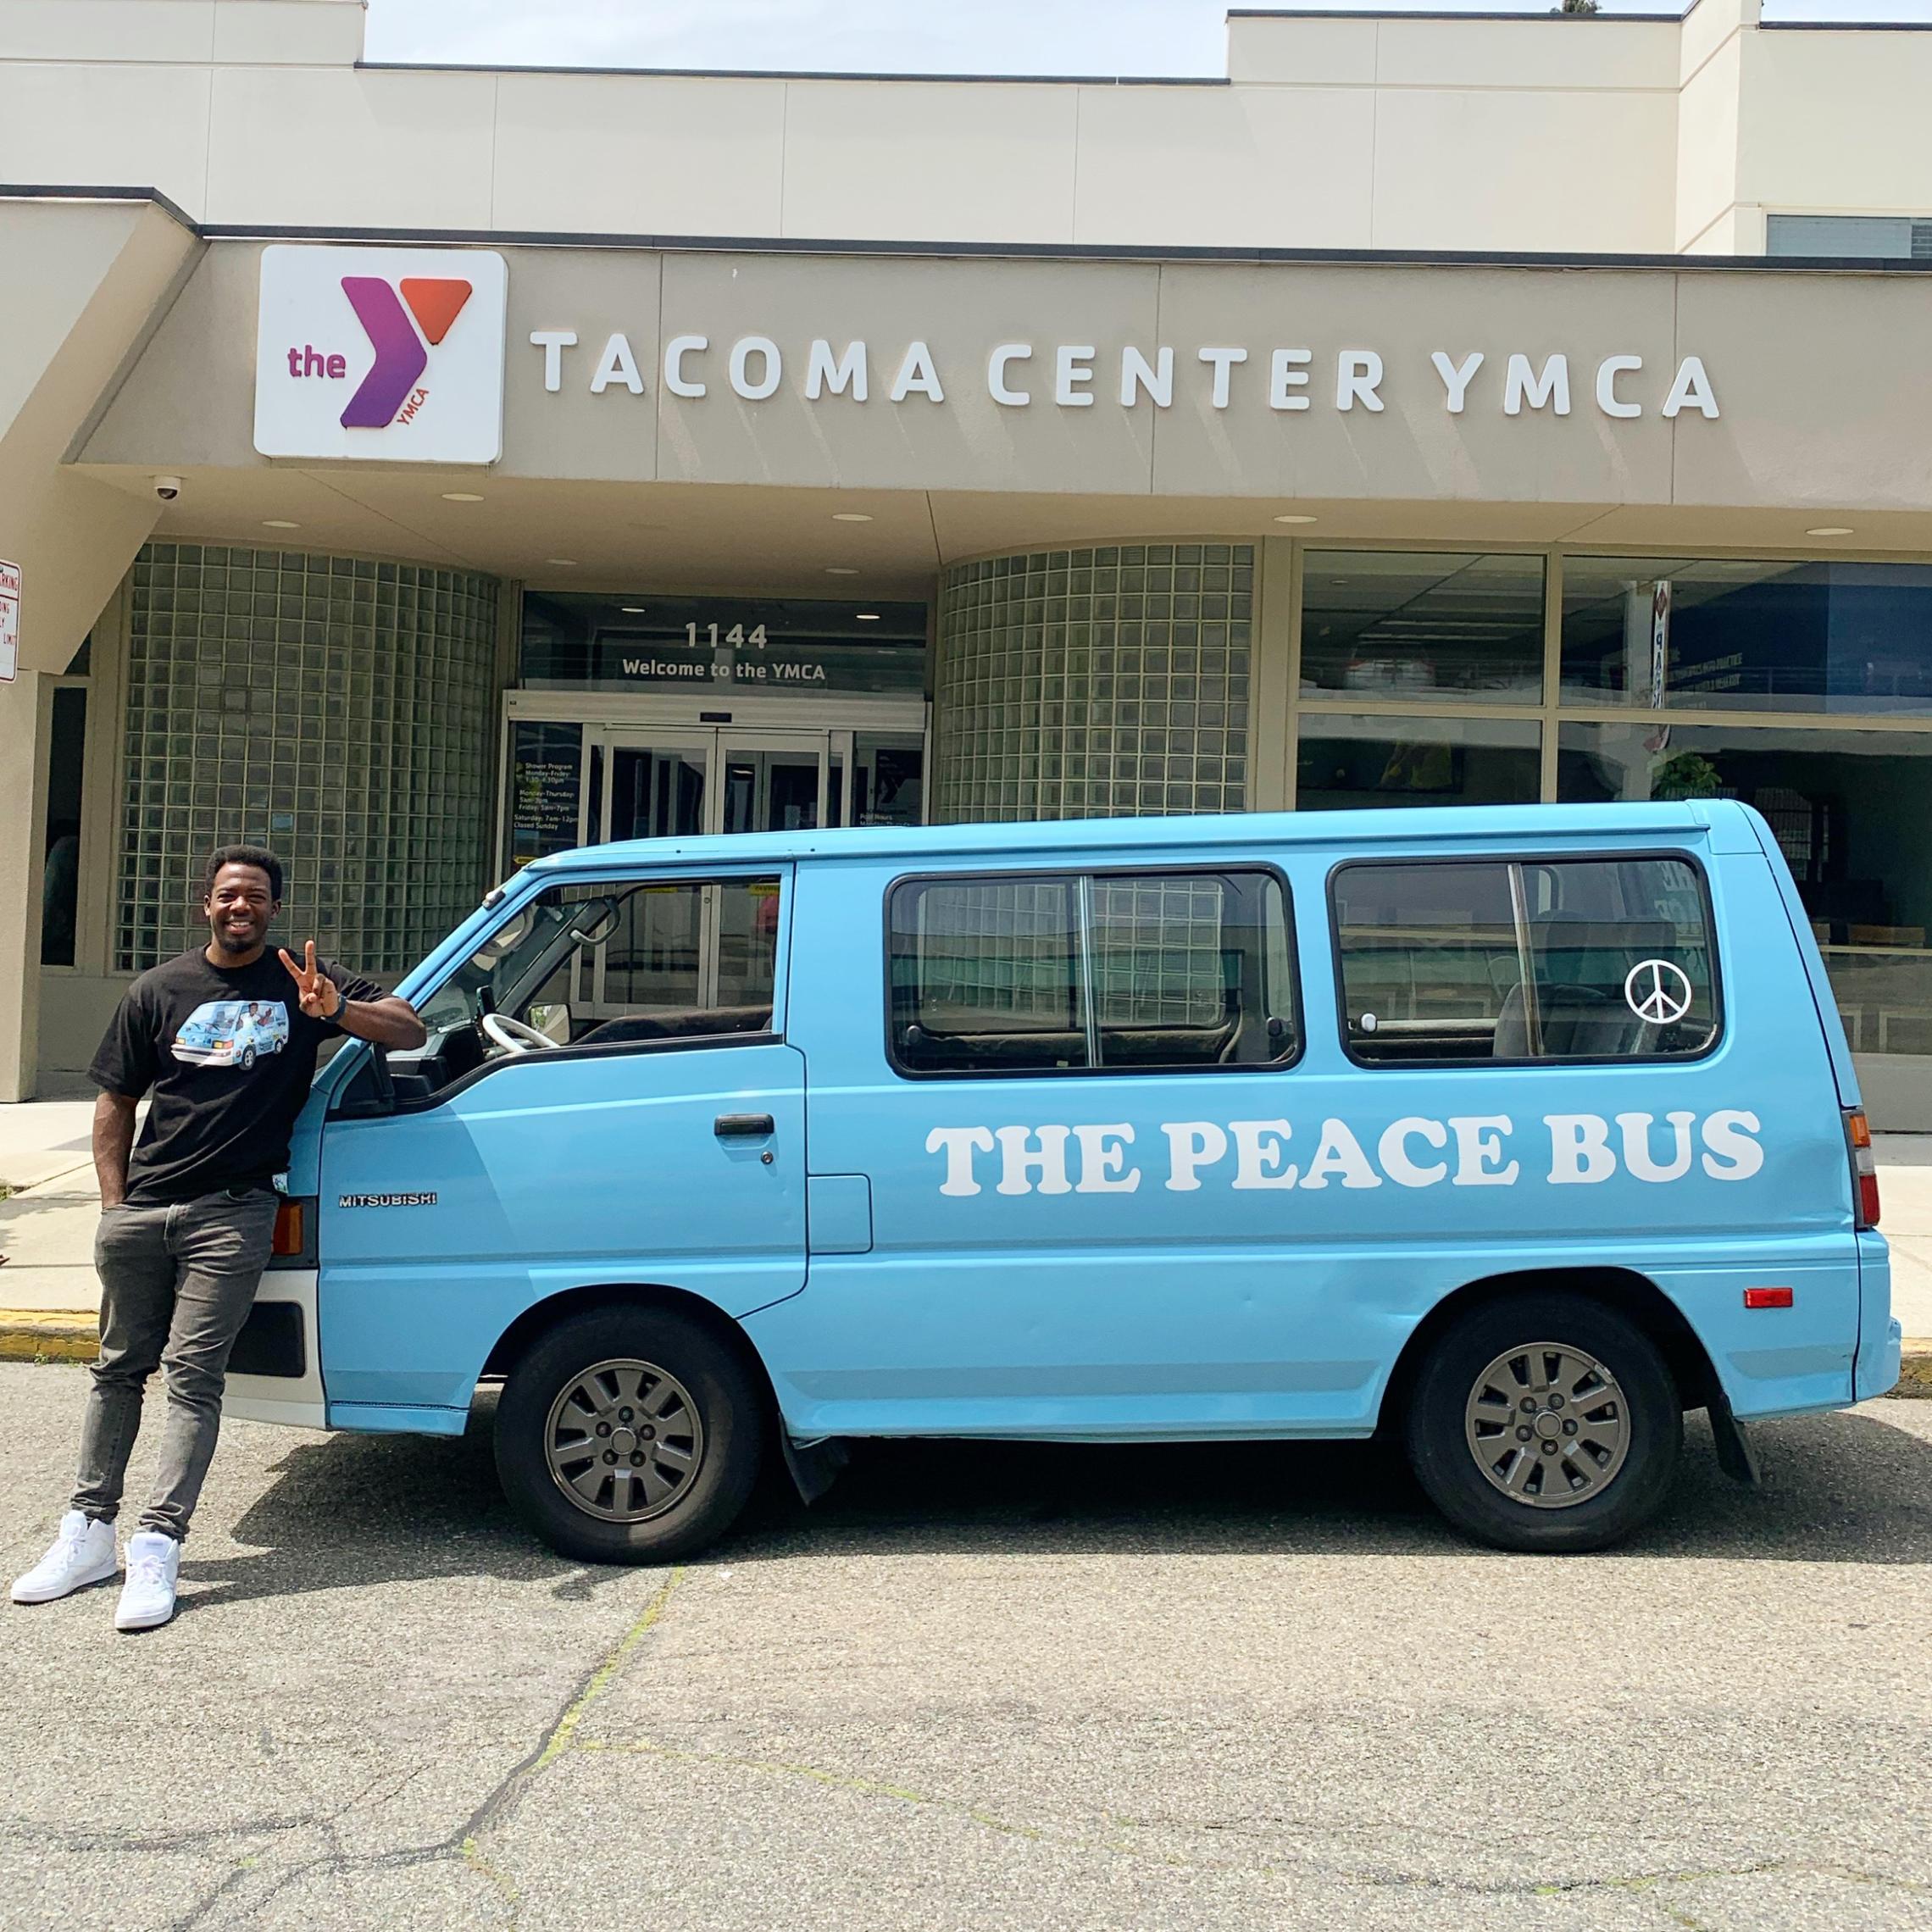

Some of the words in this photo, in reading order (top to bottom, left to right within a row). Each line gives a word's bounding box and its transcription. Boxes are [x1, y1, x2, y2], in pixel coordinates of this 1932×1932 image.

[286, 344, 347, 379] the
[529, 330, 946, 404] TACOMA
[986, 342, 1385, 413] CENTER
[1430, 350, 1721, 421] YMCA
[396, 387, 430, 425] YMCA
[685, 621, 768, 649] 1144
[622, 658, 705, 676] Welcome
[710, 661, 730, 677] to
[736, 662, 767, 678] the
[772, 663, 826, 680] YMCA
[925, 1123, 1141, 1196] THE
[1160, 1115, 1519, 1191] PEACE
[1543, 1110, 1765, 1185] BUS
[339, 1191, 438, 1208] MITSUBISHI
